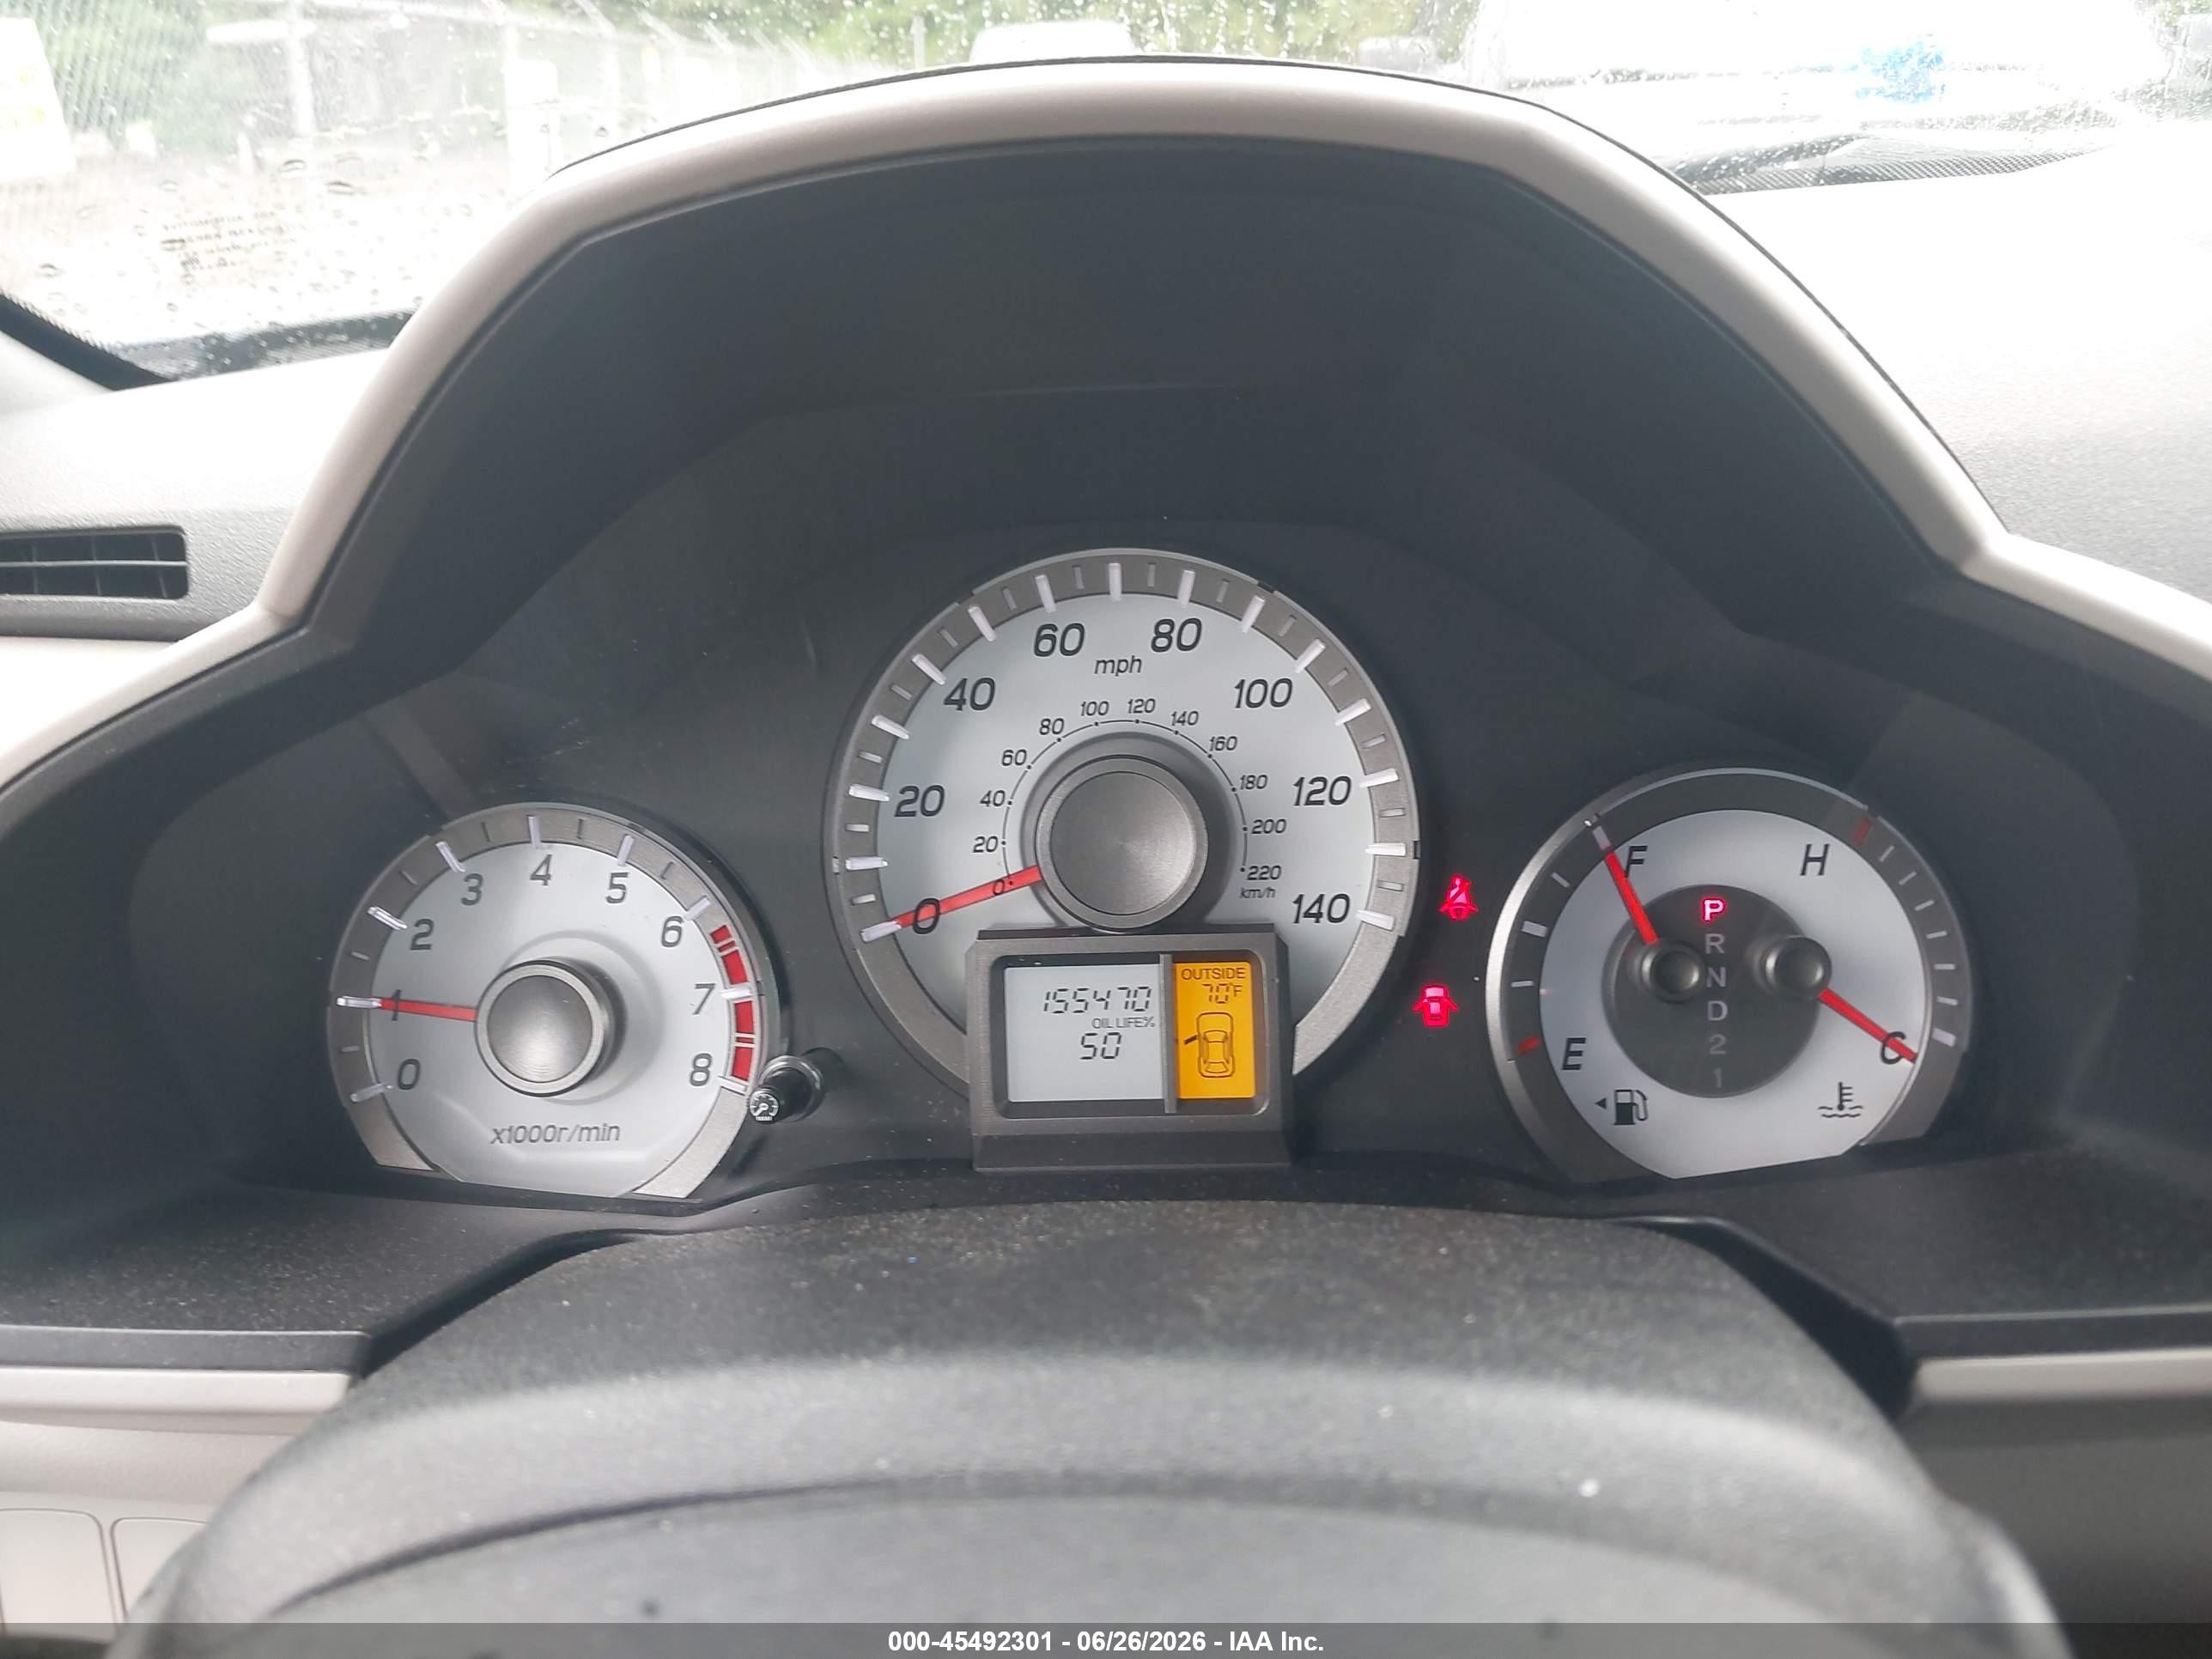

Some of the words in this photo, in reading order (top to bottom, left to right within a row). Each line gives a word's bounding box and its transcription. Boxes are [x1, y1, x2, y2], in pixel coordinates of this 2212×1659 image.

[1033, 623, 1085, 658] 60
[1152, 619, 1202, 653] 80
[1095, 656, 1142, 676] mph
[944, 678, 996, 711] 40
[1127, 698, 1156, 714] 120
[1234, 678, 1293, 708] 100
[1080, 701, 1109, 716] 100
[1170, 711, 1199, 726] 140
[1039, 718, 1065, 736] 80
[1208, 736, 1237, 751] 160
[1001, 749, 1027, 767] 60
[1239, 775, 1268, 791] 180
[1292, 776, 1352, 806] 120
[894, 785, 945, 817] 20
[979, 790, 1006, 808] 40
[1251, 818, 1287, 836] 200
[972, 836, 999, 854] 20
[529, 854, 553, 886] 4
[1247, 865, 1282, 881] 220
[1625, 845, 1648, 878] F
[1800, 843, 1830, 876] H
[460, 872, 484, 906] 3
[605, 872, 629, 904] 5
[992, 878, 1006, 896] 0
[1239, 884, 1276, 900] km/h
[913, 898, 940, 935] 0
[1291, 893, 1350, 925] 140
[1703, 899, 1725, 921] P
[410, 919, 434, 951] 2
[659, 915, 684, 948] 6
[1705, 933, 1724, 954] R
[1181, 967, 1246, 981] OUTSIDE
[1705, 968, 1726, 988] N
[390, 989, 401, 1021] 1
[691, 984, 716, 1015] 7
[1043, 987, 1151, 1014] 155470
[1707, 1000, 1728, 1021] D
[1079, 1032, 1121, 1060] 50
[1561, 1037, 1586, 1070] E
[1709, 1035, 1727, 1054] 2
[1880, 1031, 1905, 1065] C
[396, 1059, 421, 1090] 0
[690, 1053, 712, 1087] 8
